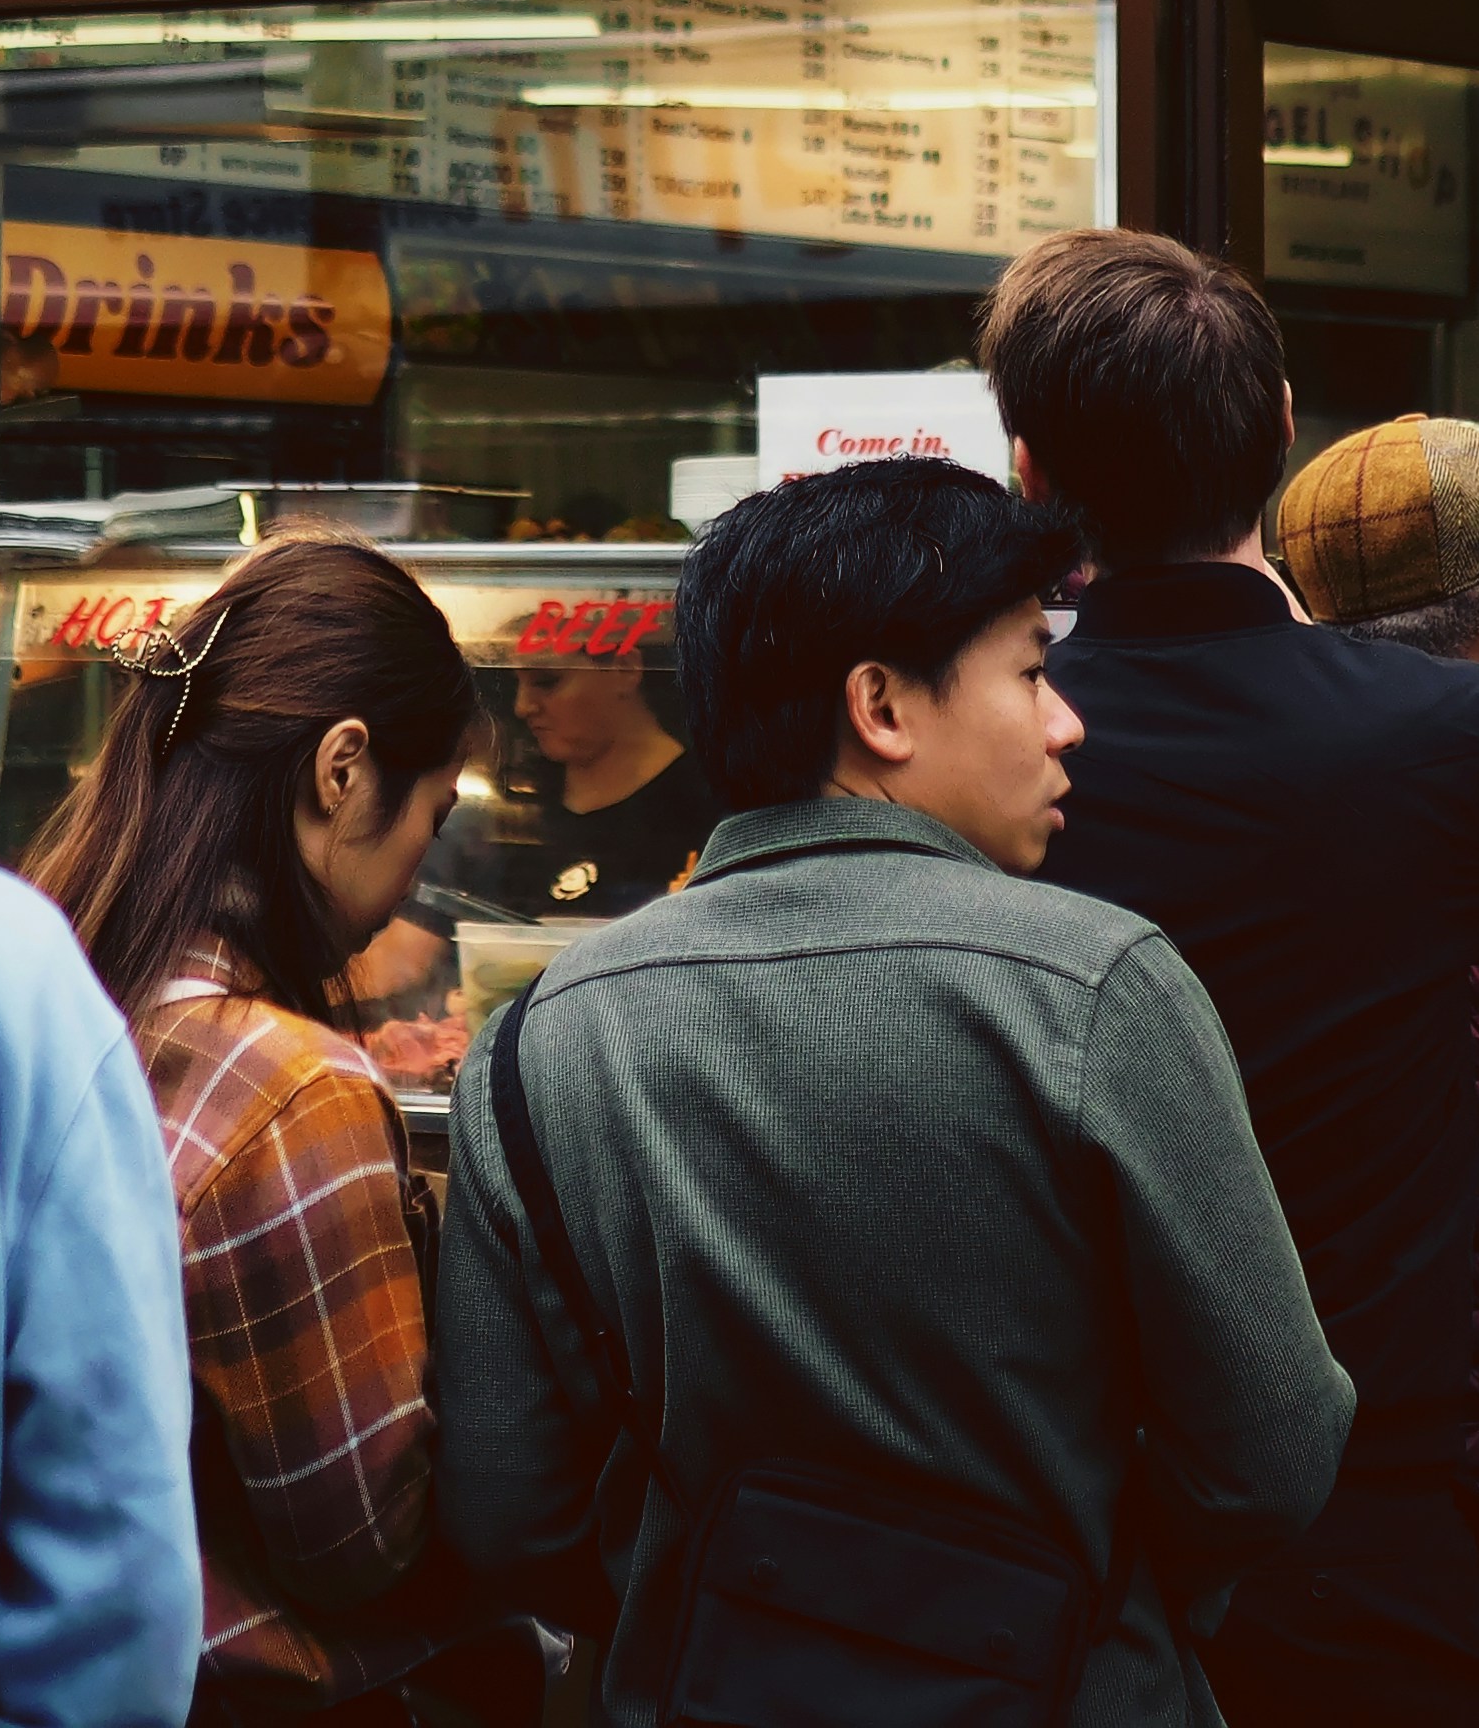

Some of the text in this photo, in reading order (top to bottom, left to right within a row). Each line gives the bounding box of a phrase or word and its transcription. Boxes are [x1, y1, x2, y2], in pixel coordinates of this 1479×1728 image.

[6, 252, 336, 369] Drinks
[816, 428, 904, 458] Come
[50, 596, 175, 651] HOT
[516, 598, 677, 656] BEEF
